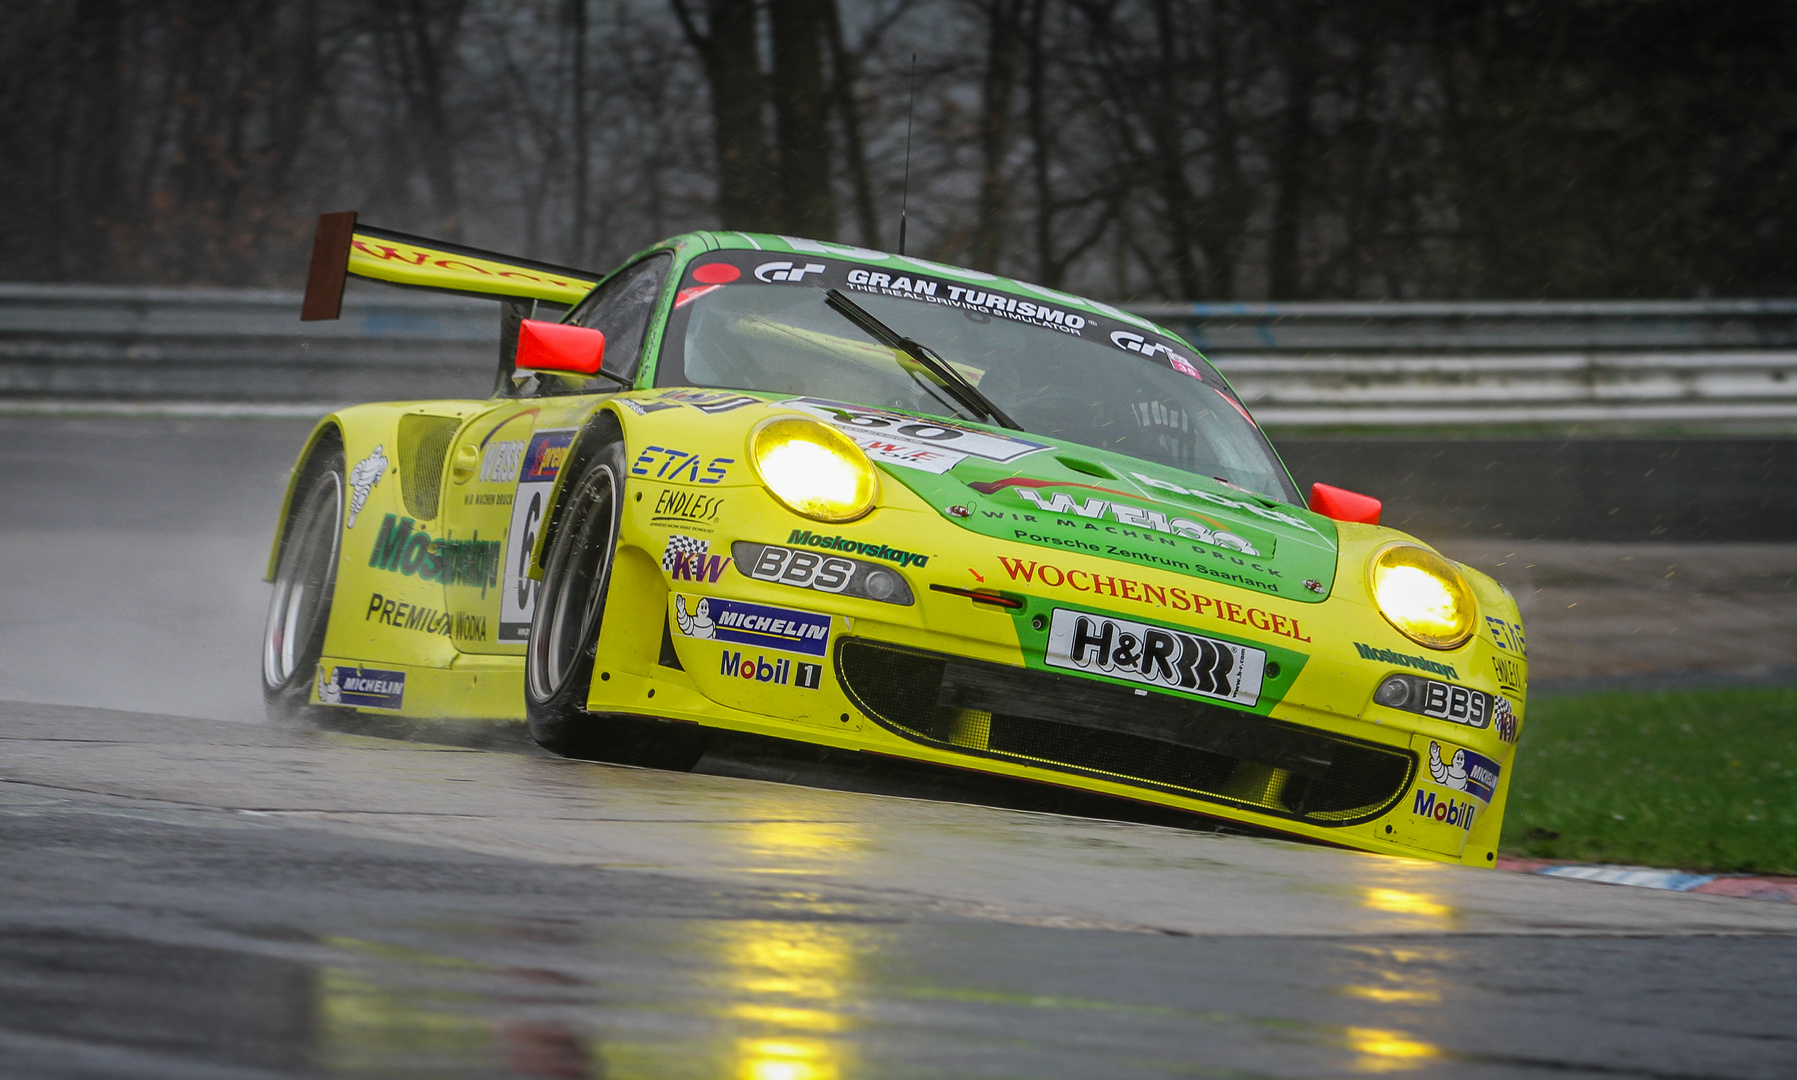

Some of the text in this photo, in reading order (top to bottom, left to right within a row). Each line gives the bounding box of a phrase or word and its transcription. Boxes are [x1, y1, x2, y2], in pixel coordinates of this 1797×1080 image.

[846, 269, 938, 296] GRAN
[947, 285, 1086, 330] TURISMO
[846, 282, 1082, 336] THE REAL DRIVING SIMULATOR
[479, 440, 525, 483] WEISS
[632, 445, 735, 484] ETAS
[655, 489, 724, 520] ENDLESS
[1014, 488, 1261, 557] WEISS
[787, 529, 929, 568] Moskovskaya
[980, 510, 1284, 579] WIR MACHEN DRUCK
[1013, 530, 1279, 593] Porsche Zentrum Saarland
[670, 550, 732, 584] KW
[751, 545, 856, 593] BBS
[997, 556, 1312, 644] WOCHENSPIEGEL
[718, 610, 828, 640] MICHELIN
[720, 650, 791, 685] Mobil
[1070, 615, 1187, 688] H&R
[1353, 641, 1460, 681] Moskovskaya
[343, 677, 403, 695] MICHELIN
[1424, 680, 1485, 728] BBS
[1412, 788, 1468, 829] Mobil
